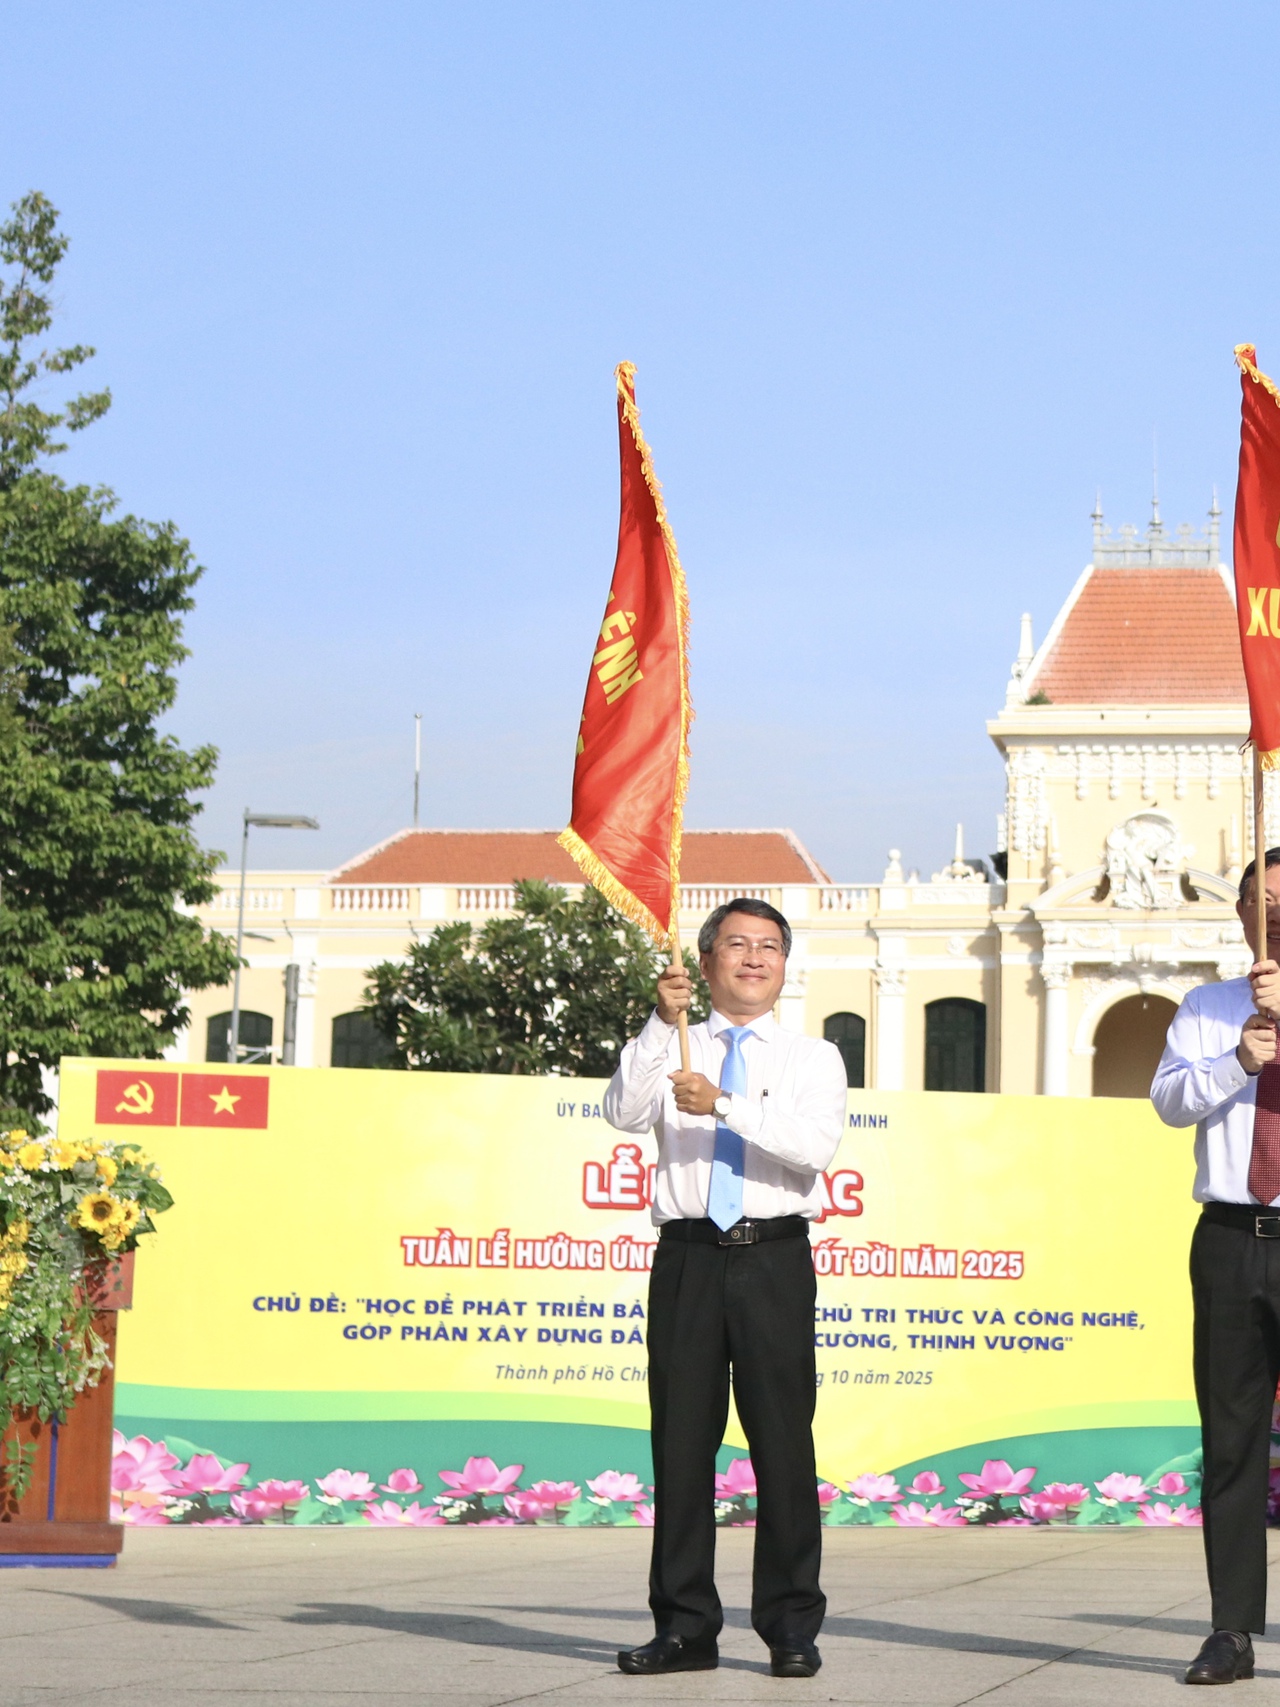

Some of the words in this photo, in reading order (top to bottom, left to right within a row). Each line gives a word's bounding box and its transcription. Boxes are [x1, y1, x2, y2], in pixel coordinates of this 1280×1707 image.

[582, 1103, 604, 1118] BA
[849, 1113, 888, 1129] MINH
[582, 1143, 646, 1211] LỄ
[401, 1228, 472, 1266] TUẦN
[476, 1228, 511, 1268] LỄ
[514, 1232, 605, 1271] HƯỞNG
[851, 1241, 897, 1277] ĐỜI
[901, 1244, 958, 1279] NĂM
[962, 1249, 1024, 1280] 2025
[252, 1292, 301, 1312] CHỦ
[309, 1292, 346, 1313] ĐỀ:
[356, 1298, 416, 1317] "HỌC
[424, 1292, 454, 1315] ĐỂ
[463, 1299, 528, 1316] PHÁT
[537, 1295, 605, 1318] TRIỂN
[613, 1299, 645, 1318] BẢ
[861, 1308, 896, 1323] TRI
[905, 1306, 963, 1324] THỨC
[973, 1308, 1006, 1325] VÀ
[1014, 1308, 1074, 1326] CÔNG
[1081, 1310, 1145, 1330] NGHỆ,
[342, 1322, 392, 1340] GÓP
[401, 1321, 468, 1342] PHẦN
[477, 1325, 528, 1342] XÂY
[537, 1327, 603, 1346] DỰNG
[611, 1325, 644, 1344] ĐẤ
[907, 1334, 975, 1352] THỊNH
[984, 1335, 1073, 1353] VƯỢNG"
[496, 1364, 548, 1380] Thành
[553, 1364, 589, 1385] phố
[592, 1364, 615, 1381] Hồ
[831, 1370, 849, 1384] 10
[854, 1369, 890, 1384] năm
[895, 1370, 933, 1385] 2025
